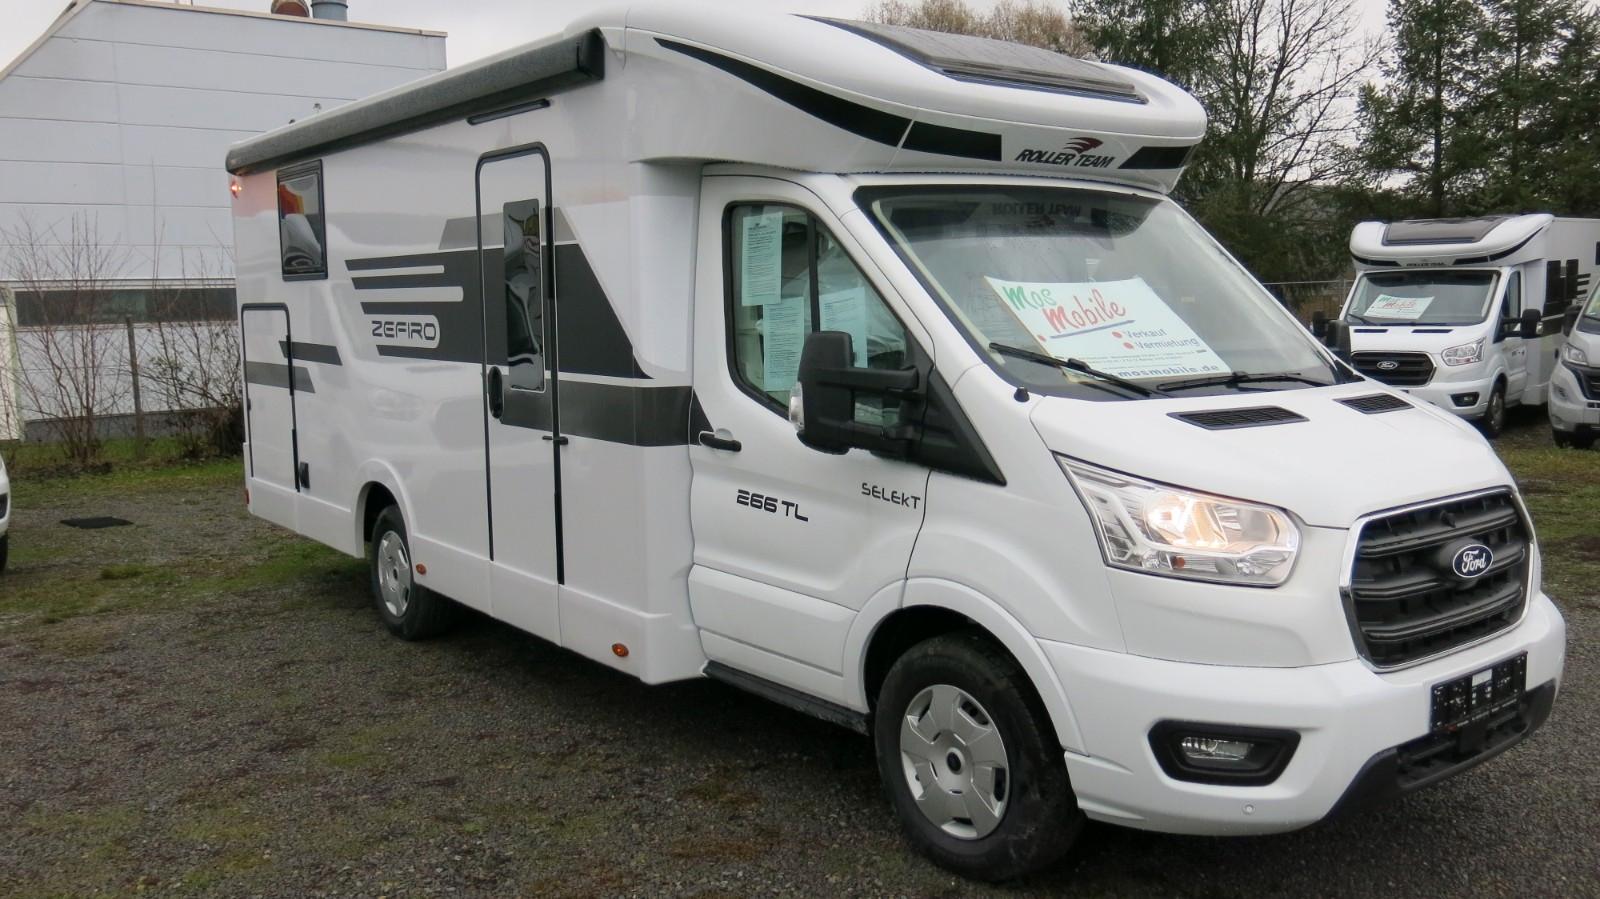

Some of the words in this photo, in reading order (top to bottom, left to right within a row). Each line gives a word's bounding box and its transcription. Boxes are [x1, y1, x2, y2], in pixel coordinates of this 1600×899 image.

[1015, 149, 1074, 166] ROLLER
[1074, 154, 1115, 168] TEAM
[371, 320, 436, 341] ZEFIRO
[1135, 338, 1200, 349] Vermietung
[736, 489, 778, 513] 266
[782, 500, 809, 522] TL
[861, 482, 921, 510] SELEKT
[1461, 549, 1487, 574] Ford
